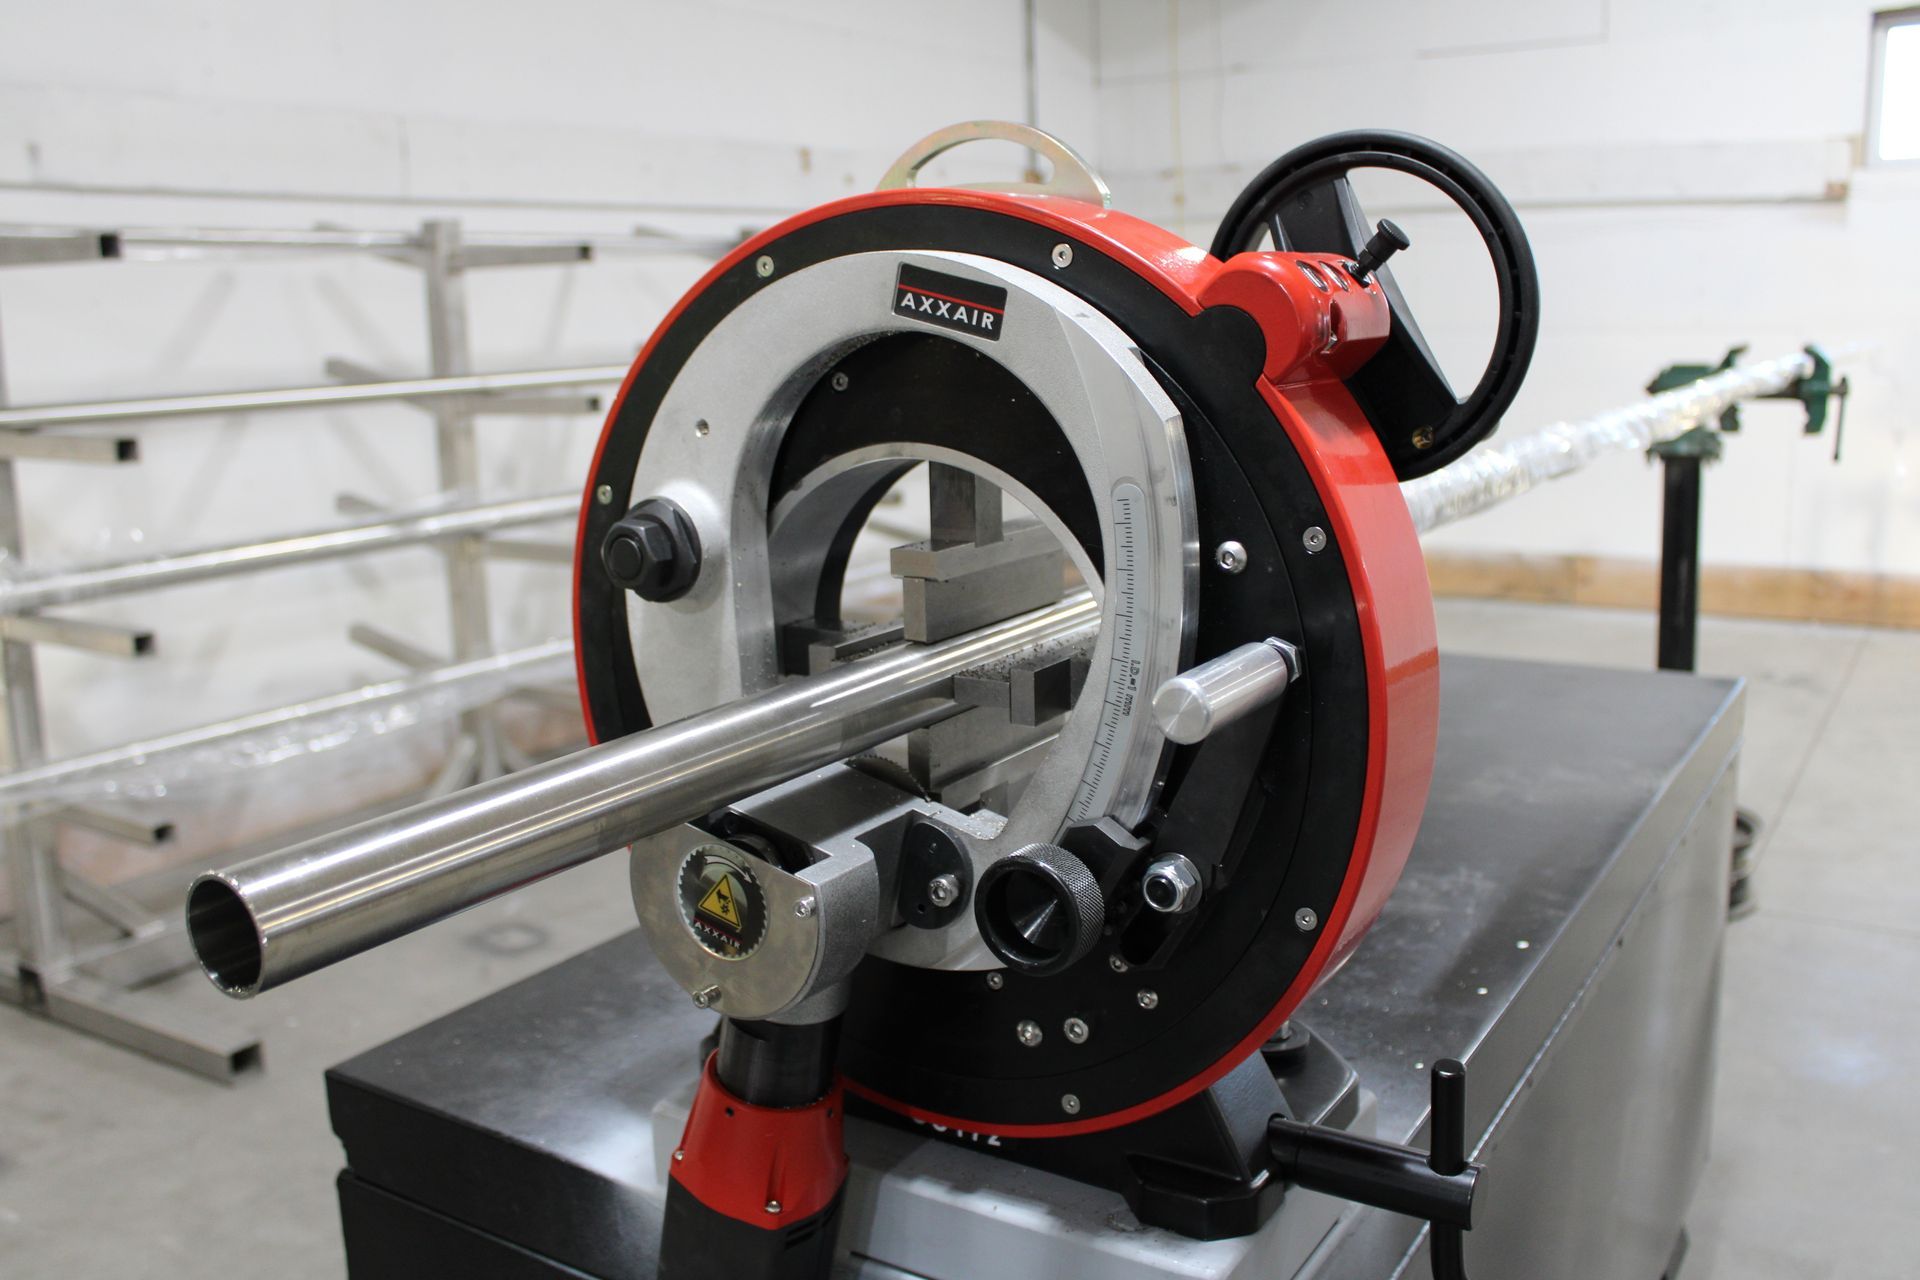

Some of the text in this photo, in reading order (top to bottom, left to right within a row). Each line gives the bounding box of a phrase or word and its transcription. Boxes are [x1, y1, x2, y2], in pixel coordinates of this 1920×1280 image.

[900, 292, 994, 330] AXXAIR
[1122, 693, 1133, 717] mm
[694, 921, 741, 949] AXXAIR
